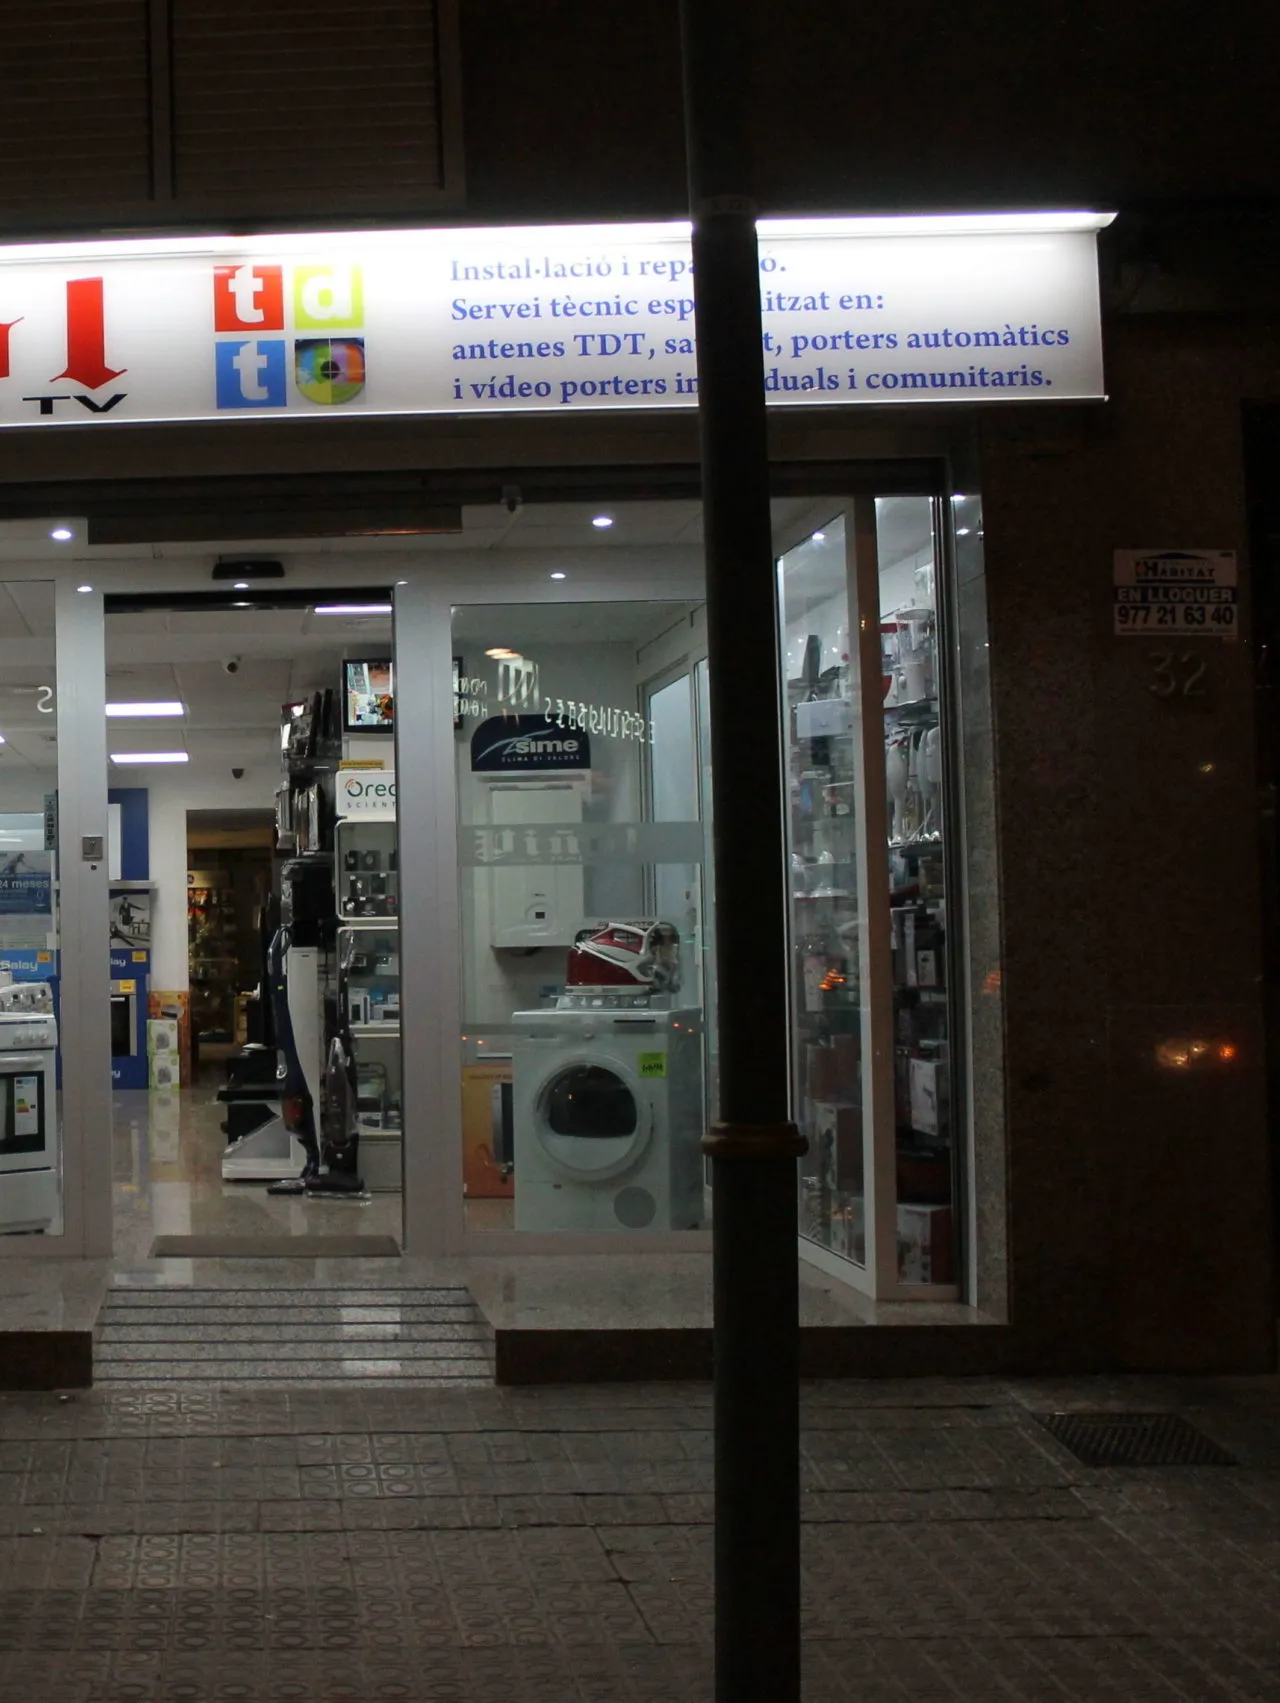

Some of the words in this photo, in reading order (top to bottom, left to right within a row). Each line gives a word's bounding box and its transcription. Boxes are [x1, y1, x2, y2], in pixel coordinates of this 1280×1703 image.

[451, 255, 612, 281] Instal·lació
[622, 256, 631, 276] i
[451, 297, 542, 321] Servei
[550, 295, 639, 318] tècnic
[839, 292, 883, 310] en:
[452, 339, 566, 360] antenes
[573, 333, 655, 360] TDT,
[791, 331, 897, 357] porters
[906, 324, 1068, 349] automàtics
[453, 378, 463, 399] i
[470, 374, 551, 399] vídeo
[559, 377, 667, 404] porters
[848, 369, 858, 389] i
[865, 365, 1052, 391] comunitaris.
[23, 393, 128, 416] TV
[1118, 588, 1142, 602] EN
[1148, 588, 1233, 602] LLOGUER
[1117, 605, 1151, 625] 977
[1157, 606, 1176, 625] 21
[1184, 605, 1206, 625] 63
[1211, 606, 1234, 625] 40
[1149, 651, 1207, 697] 32
[515, 740, 580, 754] sime
